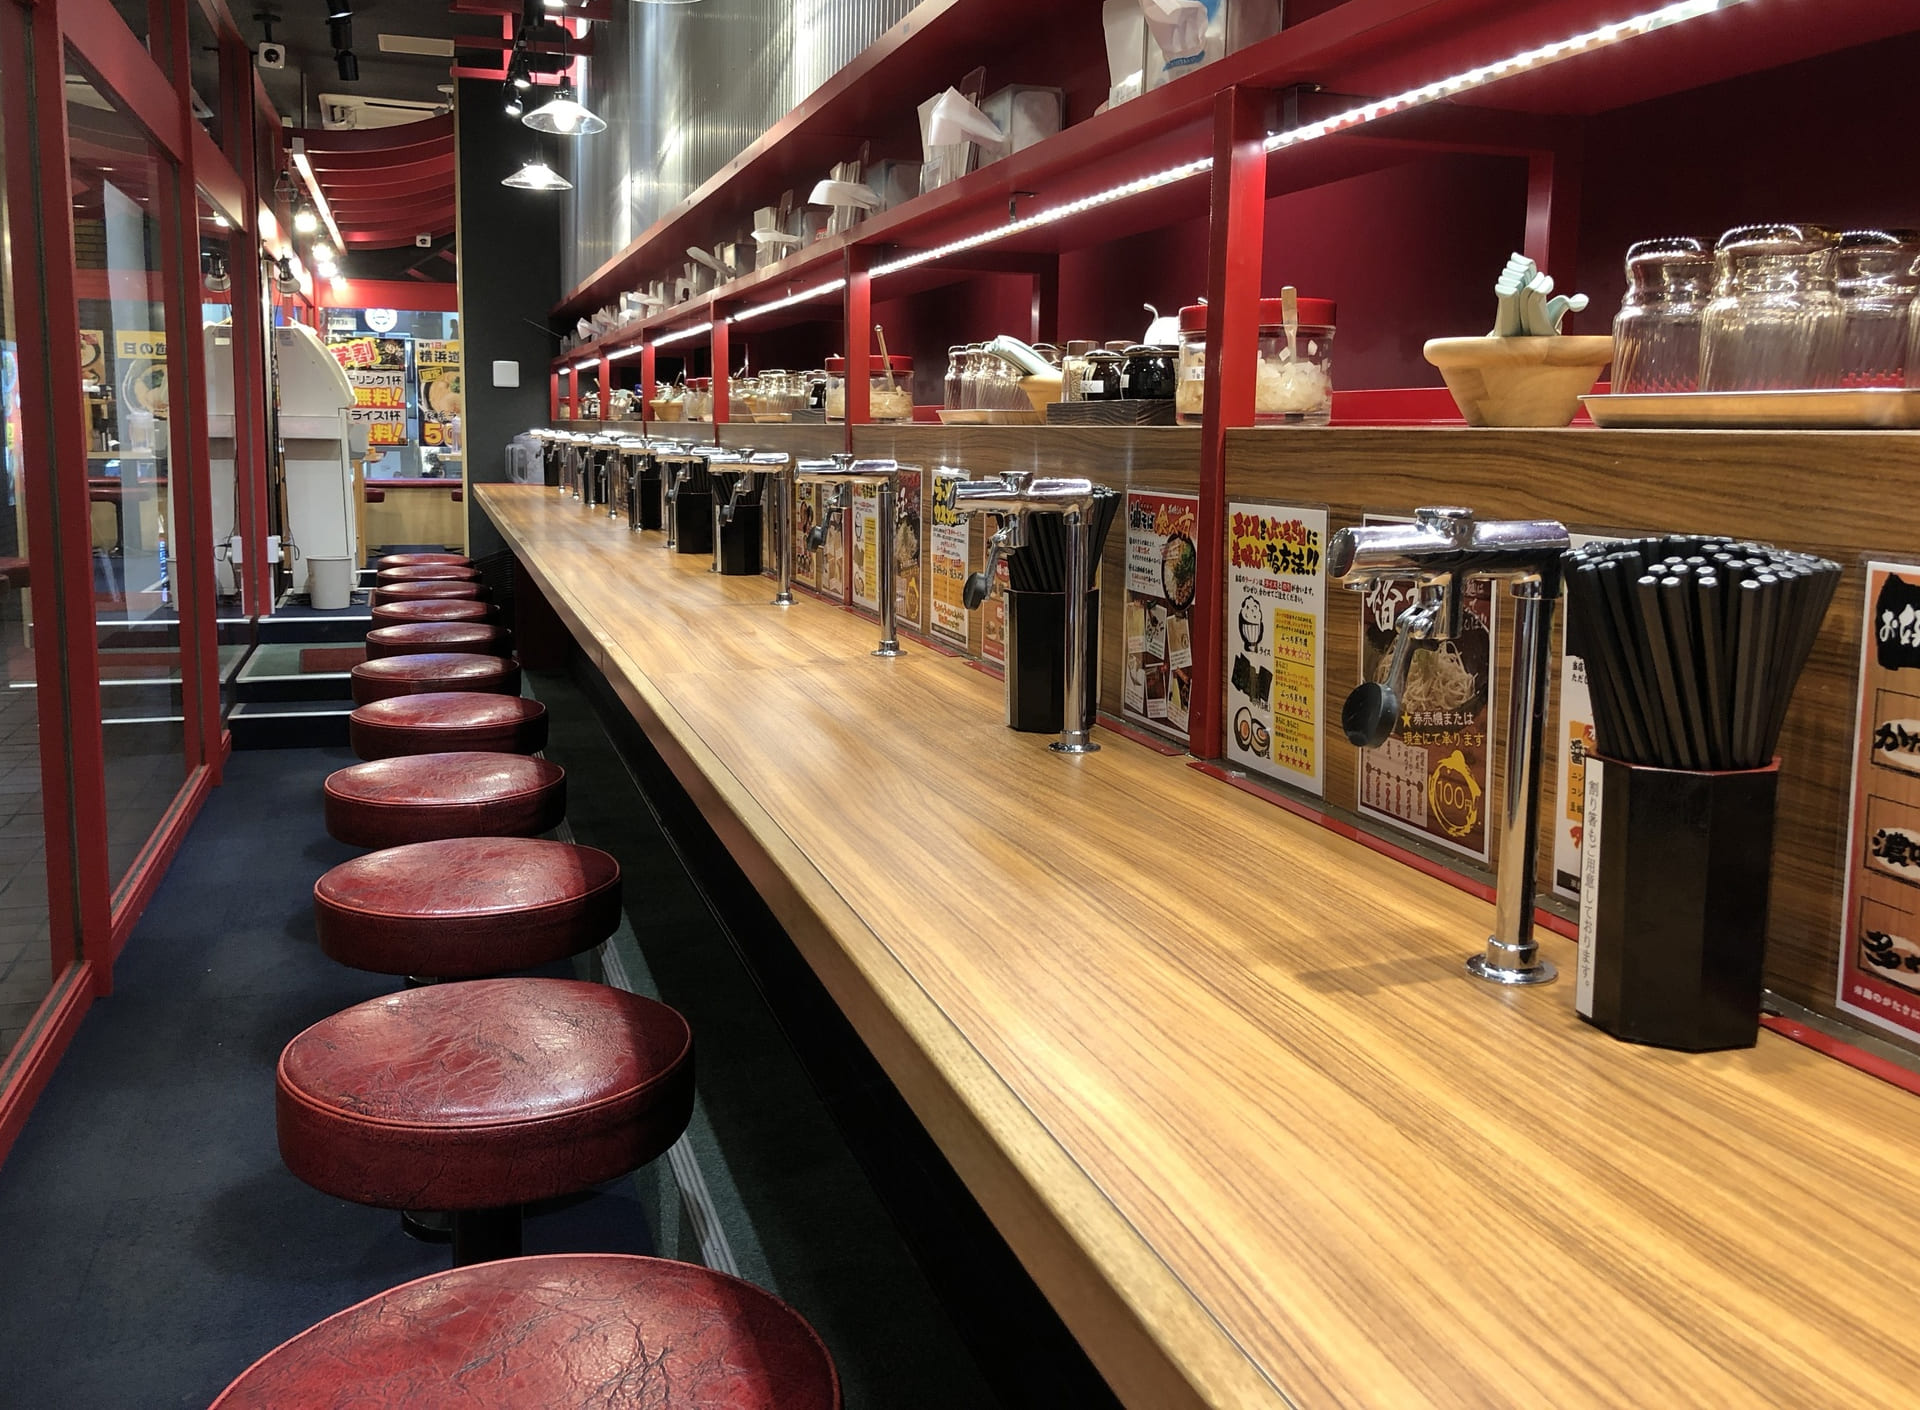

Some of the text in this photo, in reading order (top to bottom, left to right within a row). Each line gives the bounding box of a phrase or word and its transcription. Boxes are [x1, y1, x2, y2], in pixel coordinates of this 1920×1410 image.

[330, 340, 376, 367] 学割
[351, 410, 401, 420] ライス1杯
[368, 422, 404, 442] 料!
[1413, 711, 1474, 726] 券売機または
[1403, 731, 1485, 747] 現金にて承ります
[1438, 781, 1473, 815] 100円
